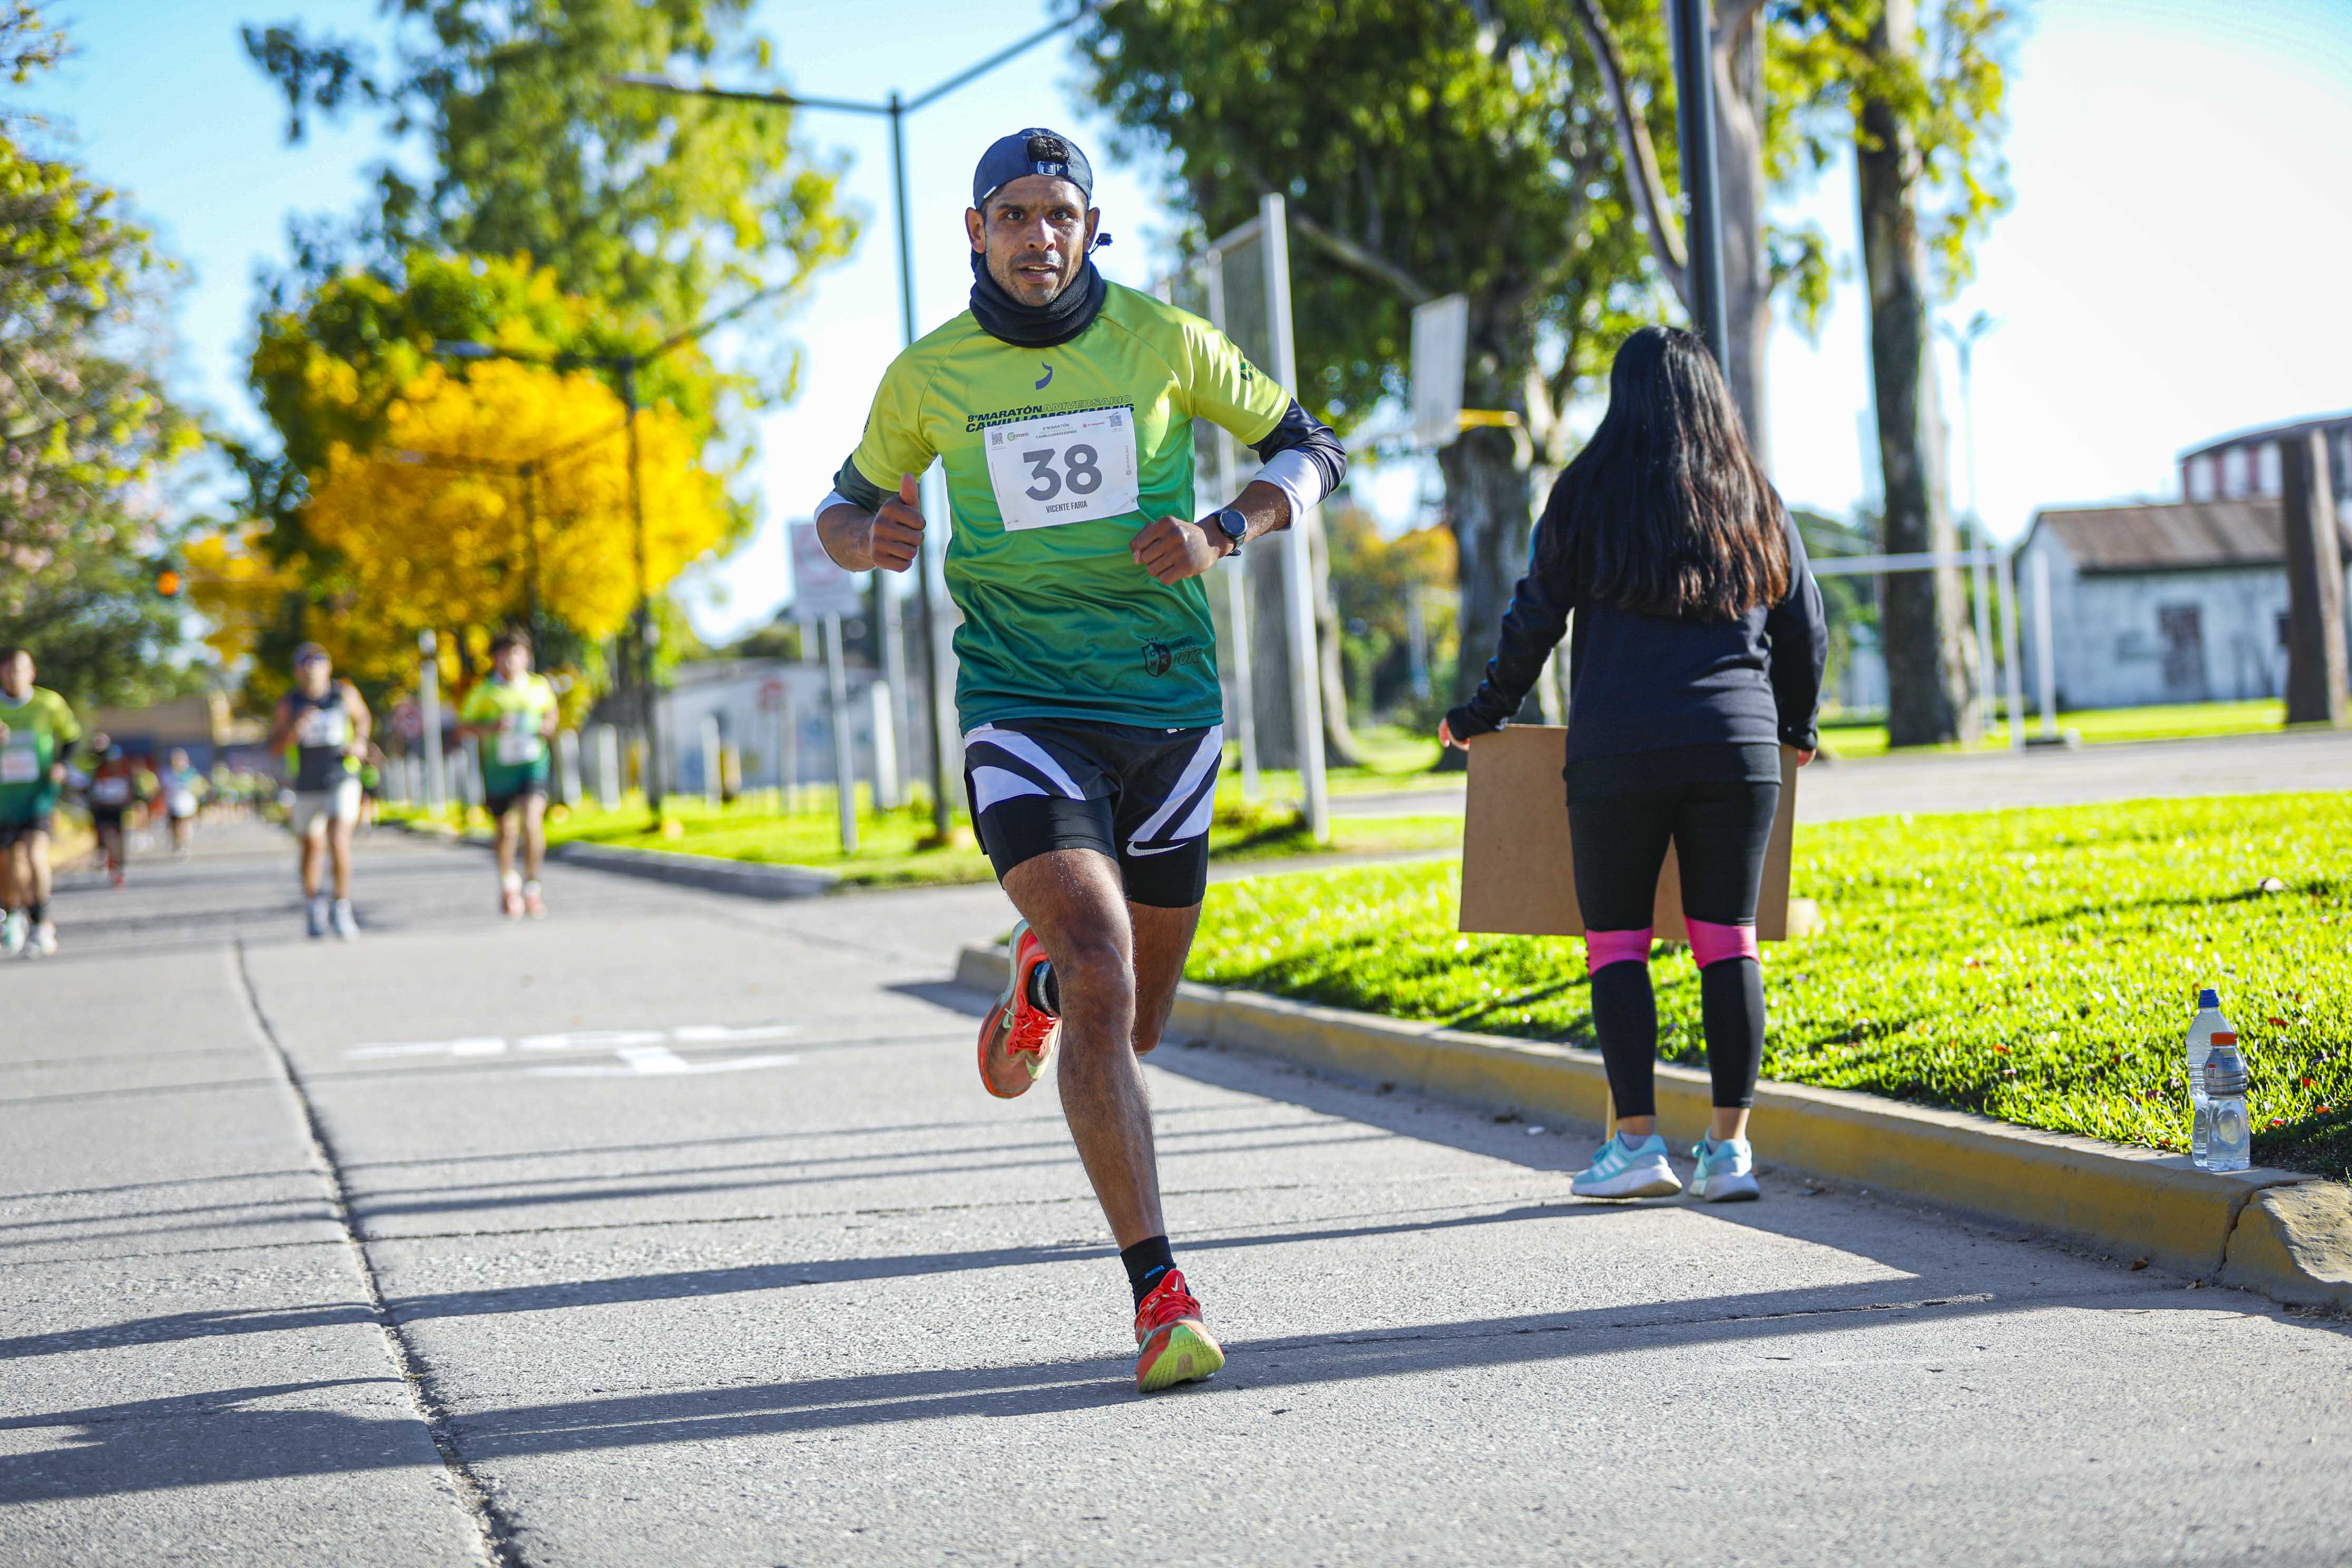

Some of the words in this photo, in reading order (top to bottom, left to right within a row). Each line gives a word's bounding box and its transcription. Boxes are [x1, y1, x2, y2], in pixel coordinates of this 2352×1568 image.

[1041, 395, 1132, 412] ANIVERSARIO
[1023, 444, 1102, 501] 38
[1046, 503, 1070, 513] VICENTE
